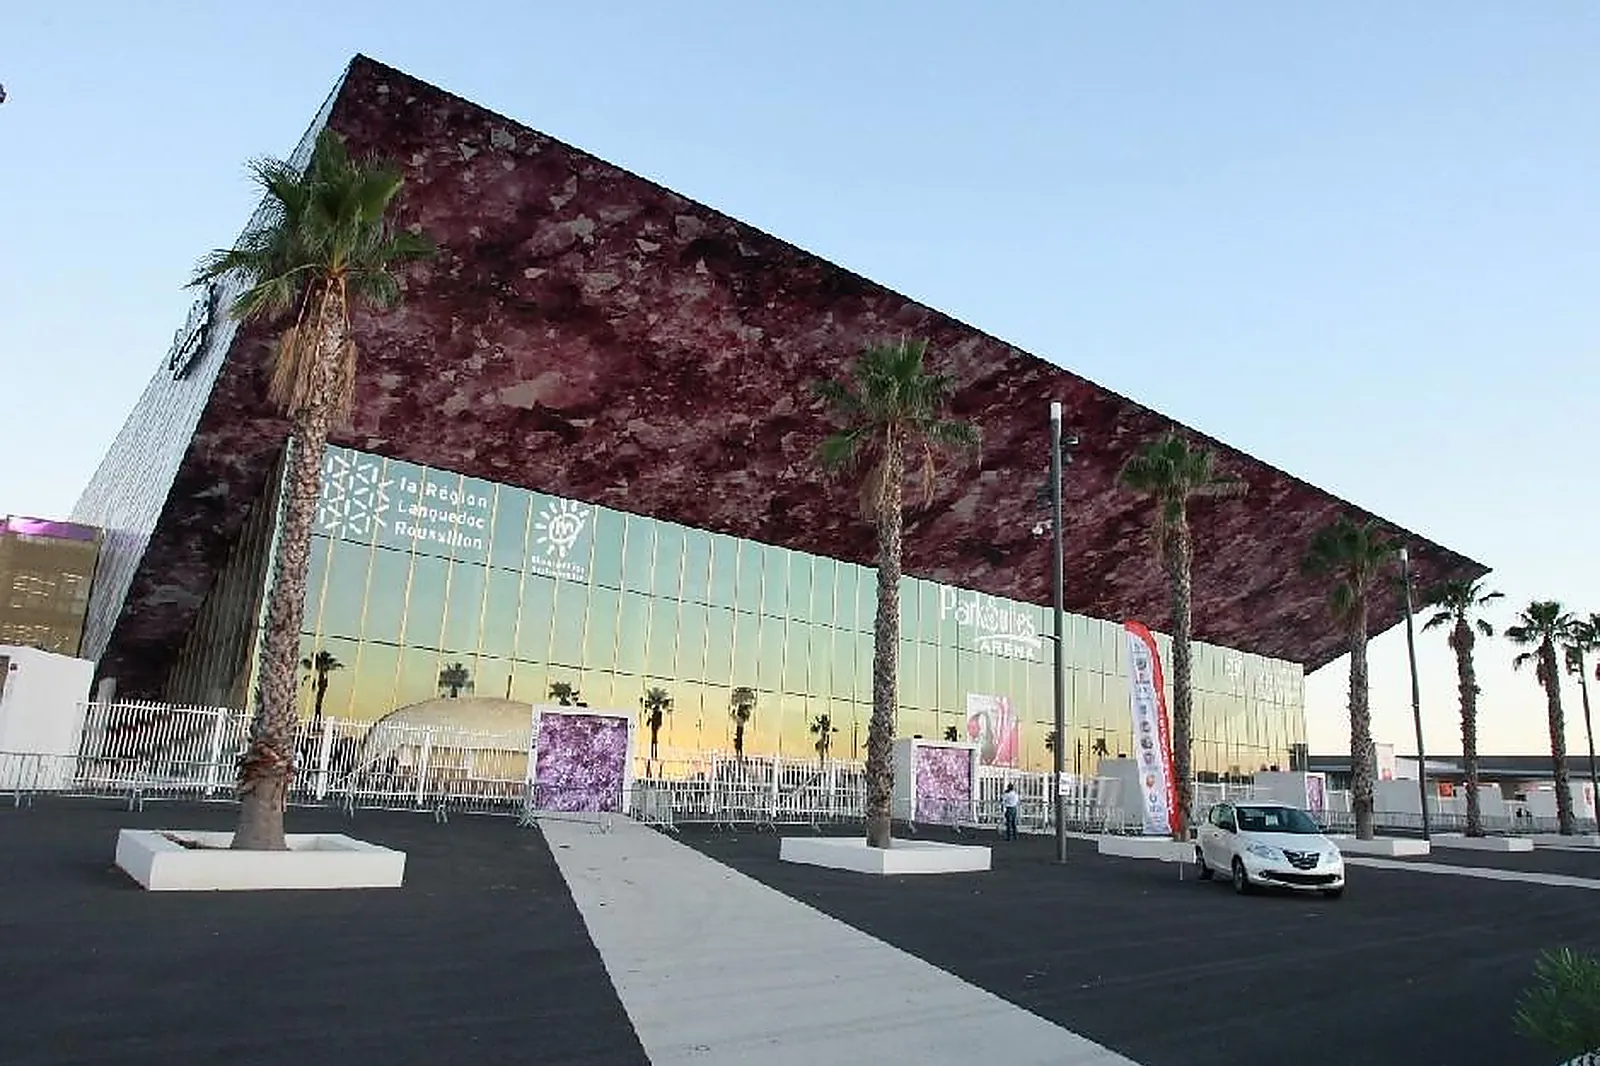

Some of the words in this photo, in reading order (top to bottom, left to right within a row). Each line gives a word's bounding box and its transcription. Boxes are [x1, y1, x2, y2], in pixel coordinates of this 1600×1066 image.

[400, 476, 417, 494] la
[425, 482, 488, 509] Région
[398, 499, 486, 529] Languedoc
[394, 521, 483, 550] Roussillon
[980, 639, 1034, 659] ARENA
